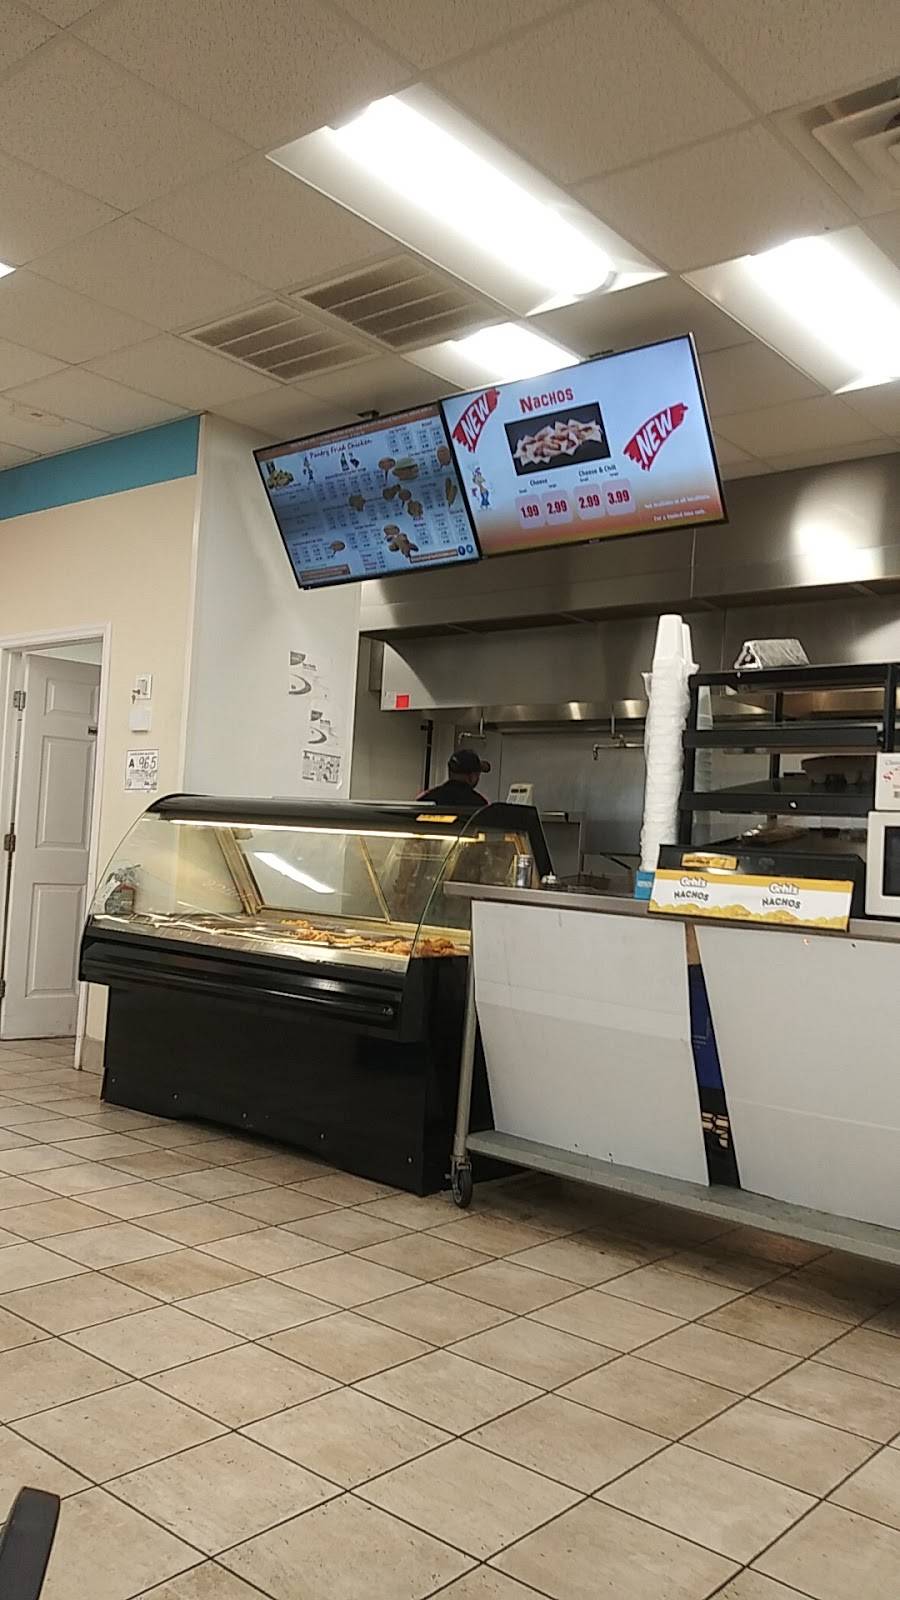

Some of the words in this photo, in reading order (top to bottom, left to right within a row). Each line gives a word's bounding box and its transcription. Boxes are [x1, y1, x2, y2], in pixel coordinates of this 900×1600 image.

[460, 394, 490, 448] NEW
[636, 408, 673, 465] NEW
[330, 444, 346, 455] Fried
[348, 439, 373, 449] Chicken
[578, 468, 598, 477] Cheese
[529, 478, 548, 486] Cheese
[579, 494, 601, 509] 2.99
[607, 489, 631, 505] 3.99
[521, 505, 540, 518] 1.99
[546, 500, 568, 514] 2.99
[674, 890, 709, 902] NACHOS
[762, 897, 801, 909] NACHOS
